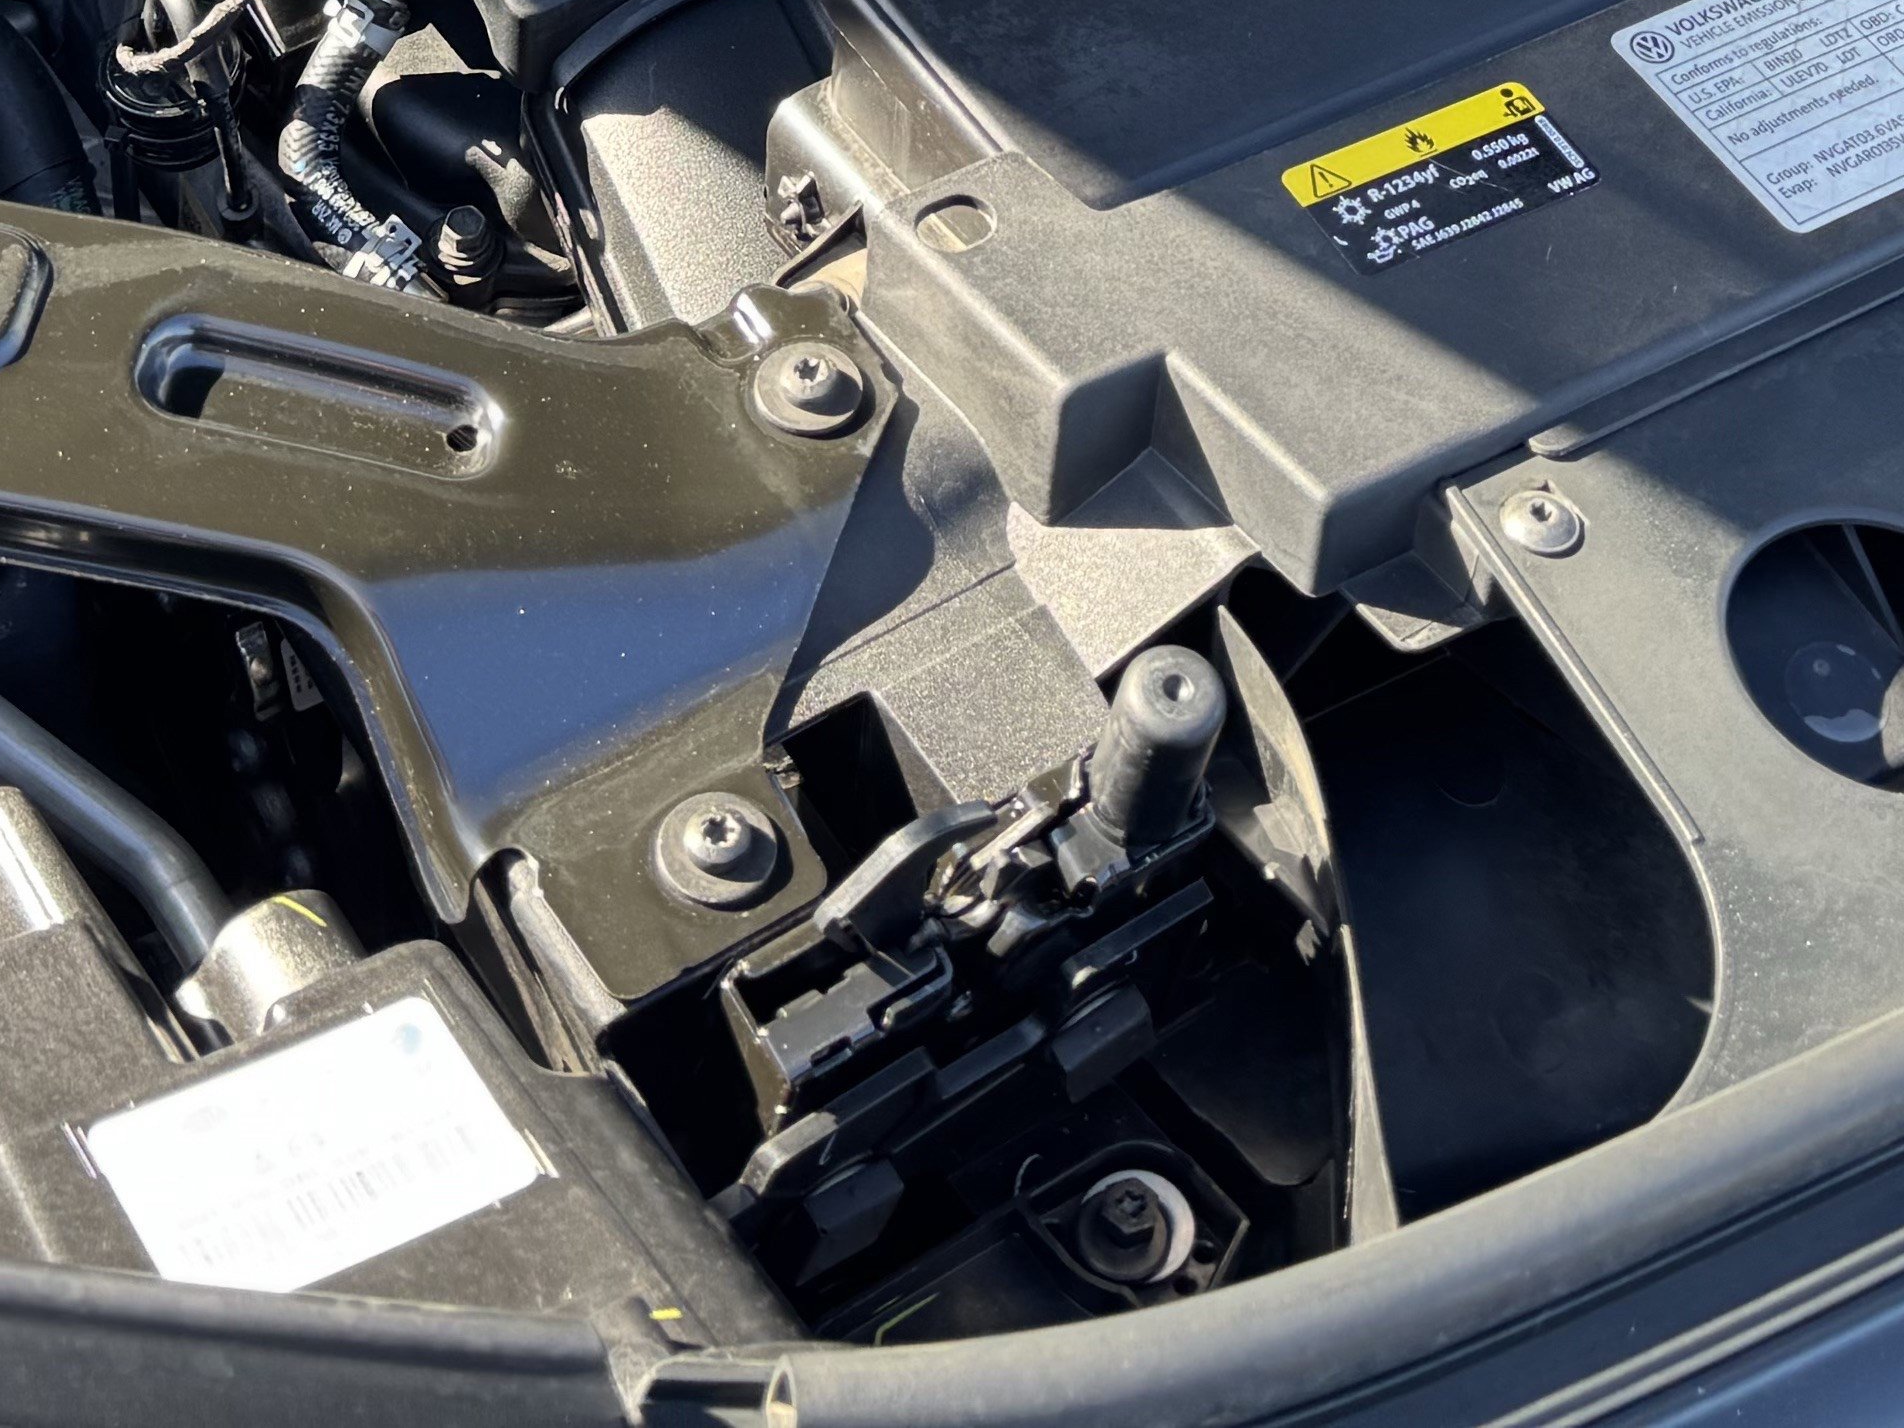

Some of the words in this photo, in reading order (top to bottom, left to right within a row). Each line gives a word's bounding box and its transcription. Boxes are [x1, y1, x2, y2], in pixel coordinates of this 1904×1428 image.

[1670, 53, 1732, 84] Conforms
[1731, 46, 1749, 58] to
[1750, 16, 1822, 52] regulations:
[1681, 21, 1733, 48] VEHICLE
[1688, 86, 1716, 103] U.S.
[1714, 74, 1745, 92] EPA:
[1859, 10, 1894, 29] OBD:
[1705, 86, 1771, 120] California:
[1781, 62, 1828, 87] ULEV70
[1835, 47, 1863, 63] LDT
[1727, 130, 1751, 145] No
[1749, 96, 1829, 137] adjustments
[1827, 73, 1878, 100] needed.
[1367, 165, 1442, 203] R-1234yf
[1470, 138, 1510, 160] 0.550
[1505, 130, 1530, 148] kg
[1546, 175, 1575, 193] VW
[1570, 167, 1596, 183] AG
[1765, 158, 1814, 186] Group:
[1778, 176, 1819, 201] Evap:
[1382, 202, 1412, 219] GWP
[1397, 216, 1435, 238] PAG
[1410, 233, 1436, 249] SAE
[1431, 223, 1461, 241] J639
[1490, 197, 1524, 217] J2845
